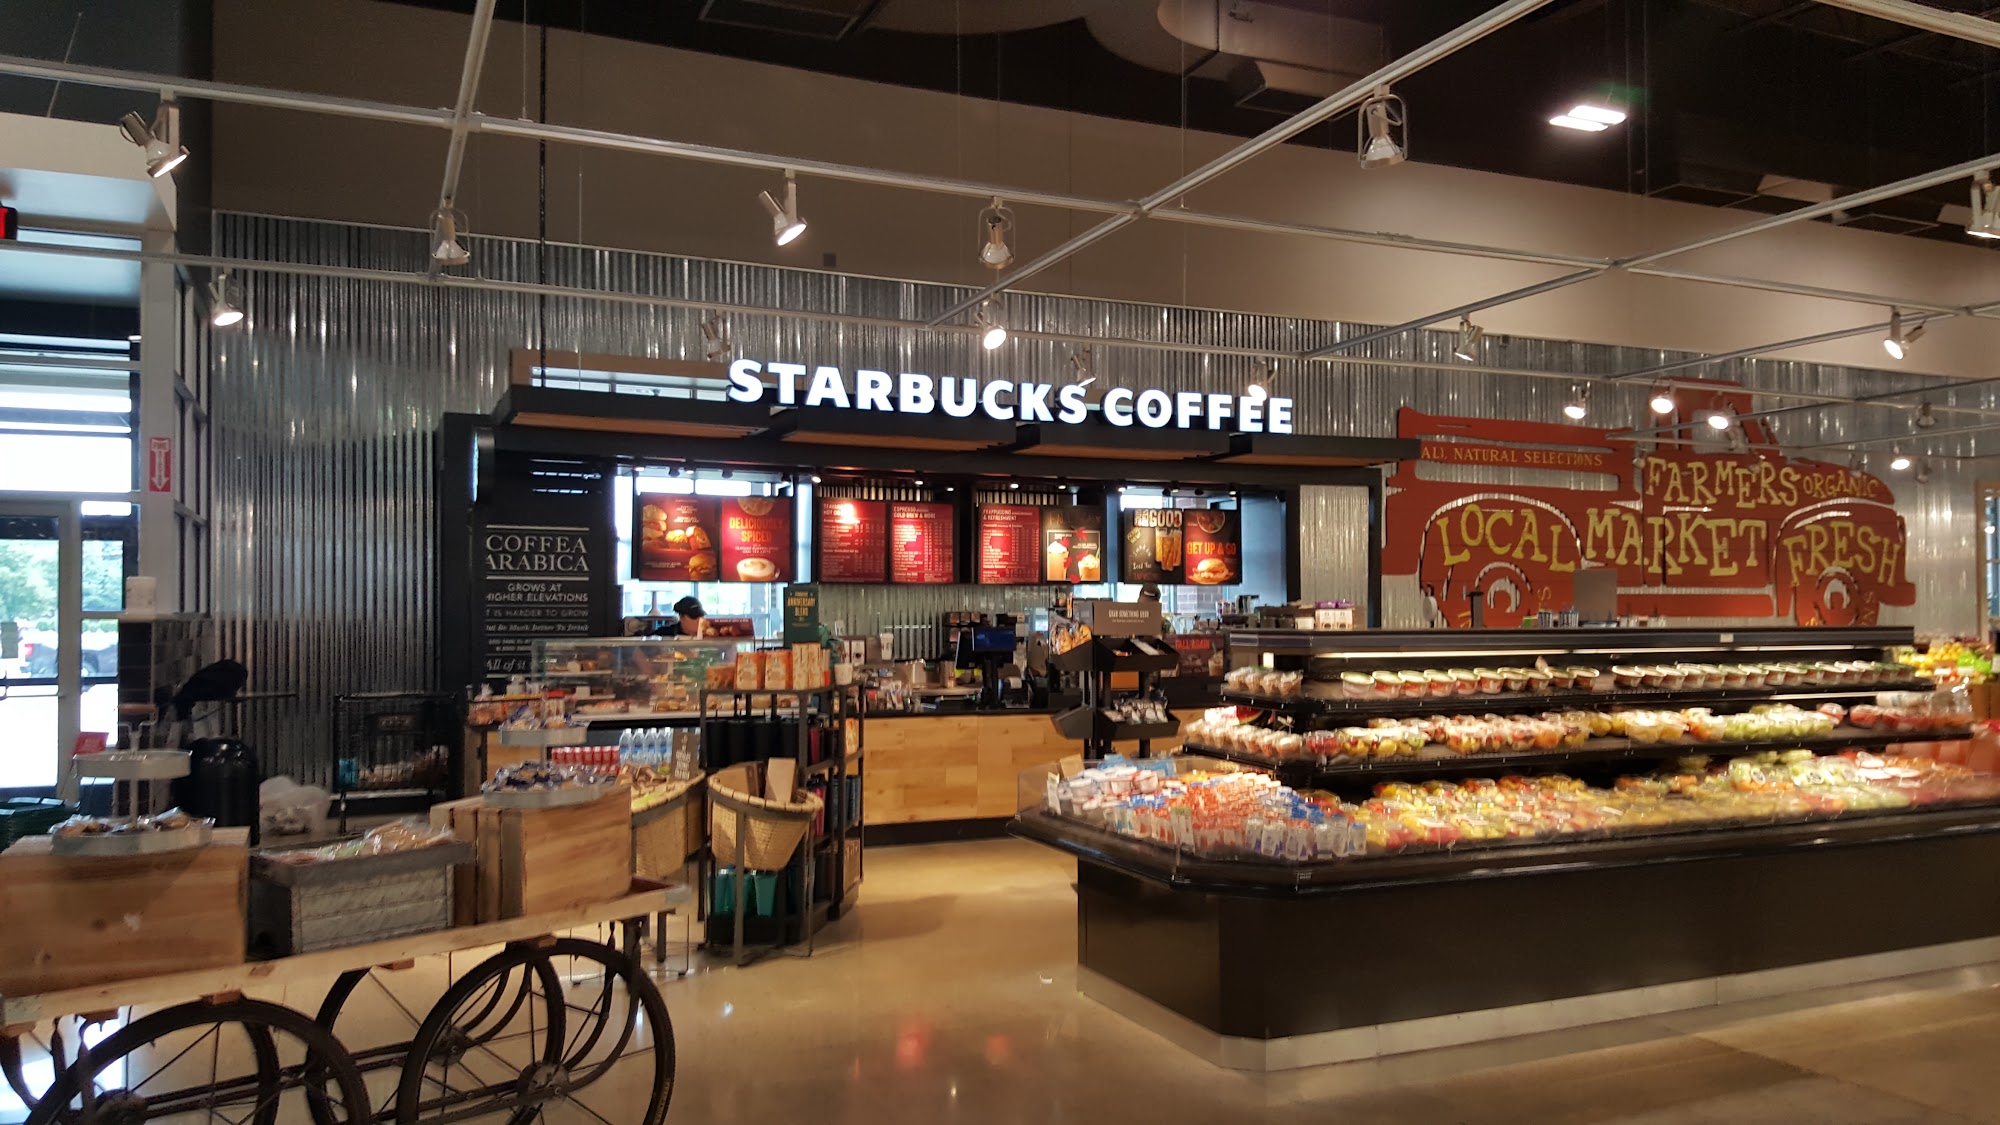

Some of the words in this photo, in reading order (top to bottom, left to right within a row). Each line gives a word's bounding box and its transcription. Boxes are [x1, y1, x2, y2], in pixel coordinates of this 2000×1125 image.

[727, 358, 1087, 425] STARBUCKS
[1103, 387, 1293, 434] COFFEE
[1421, 446, 1448, 461] ALL
[1453, 447, 1519, 463] NATURAL
[1523, 450, 1603, 467] SELECTIONS
[1646, 456, 1801, 509] FARMERS
[1802, 475, 1879, 500] ORGANIC
[729, 517, 784, 529] DELICIOUSLY
[1149, 509, 1183, 528] GOOD
[486, 535, 588, 554] COFFEA
[741, 530, 772, 543] SPICED
[1435, 503, 1575, 572] LOCAL
[1585, 508, 1768, 577] MARKET
[1187, 541, 1203, 555] GET
[1204, 541, 1216, 555] UP
[1217, 542, 1224, 555] &
[1782, 521, 1901, 587] FRESH
[486, 553, 589, 572] ARABICA
[508, 583, 546, 592] GROWS
[549, 583, 562, 592] AT
[526, 593, 588, 602] ELEVATIONS
